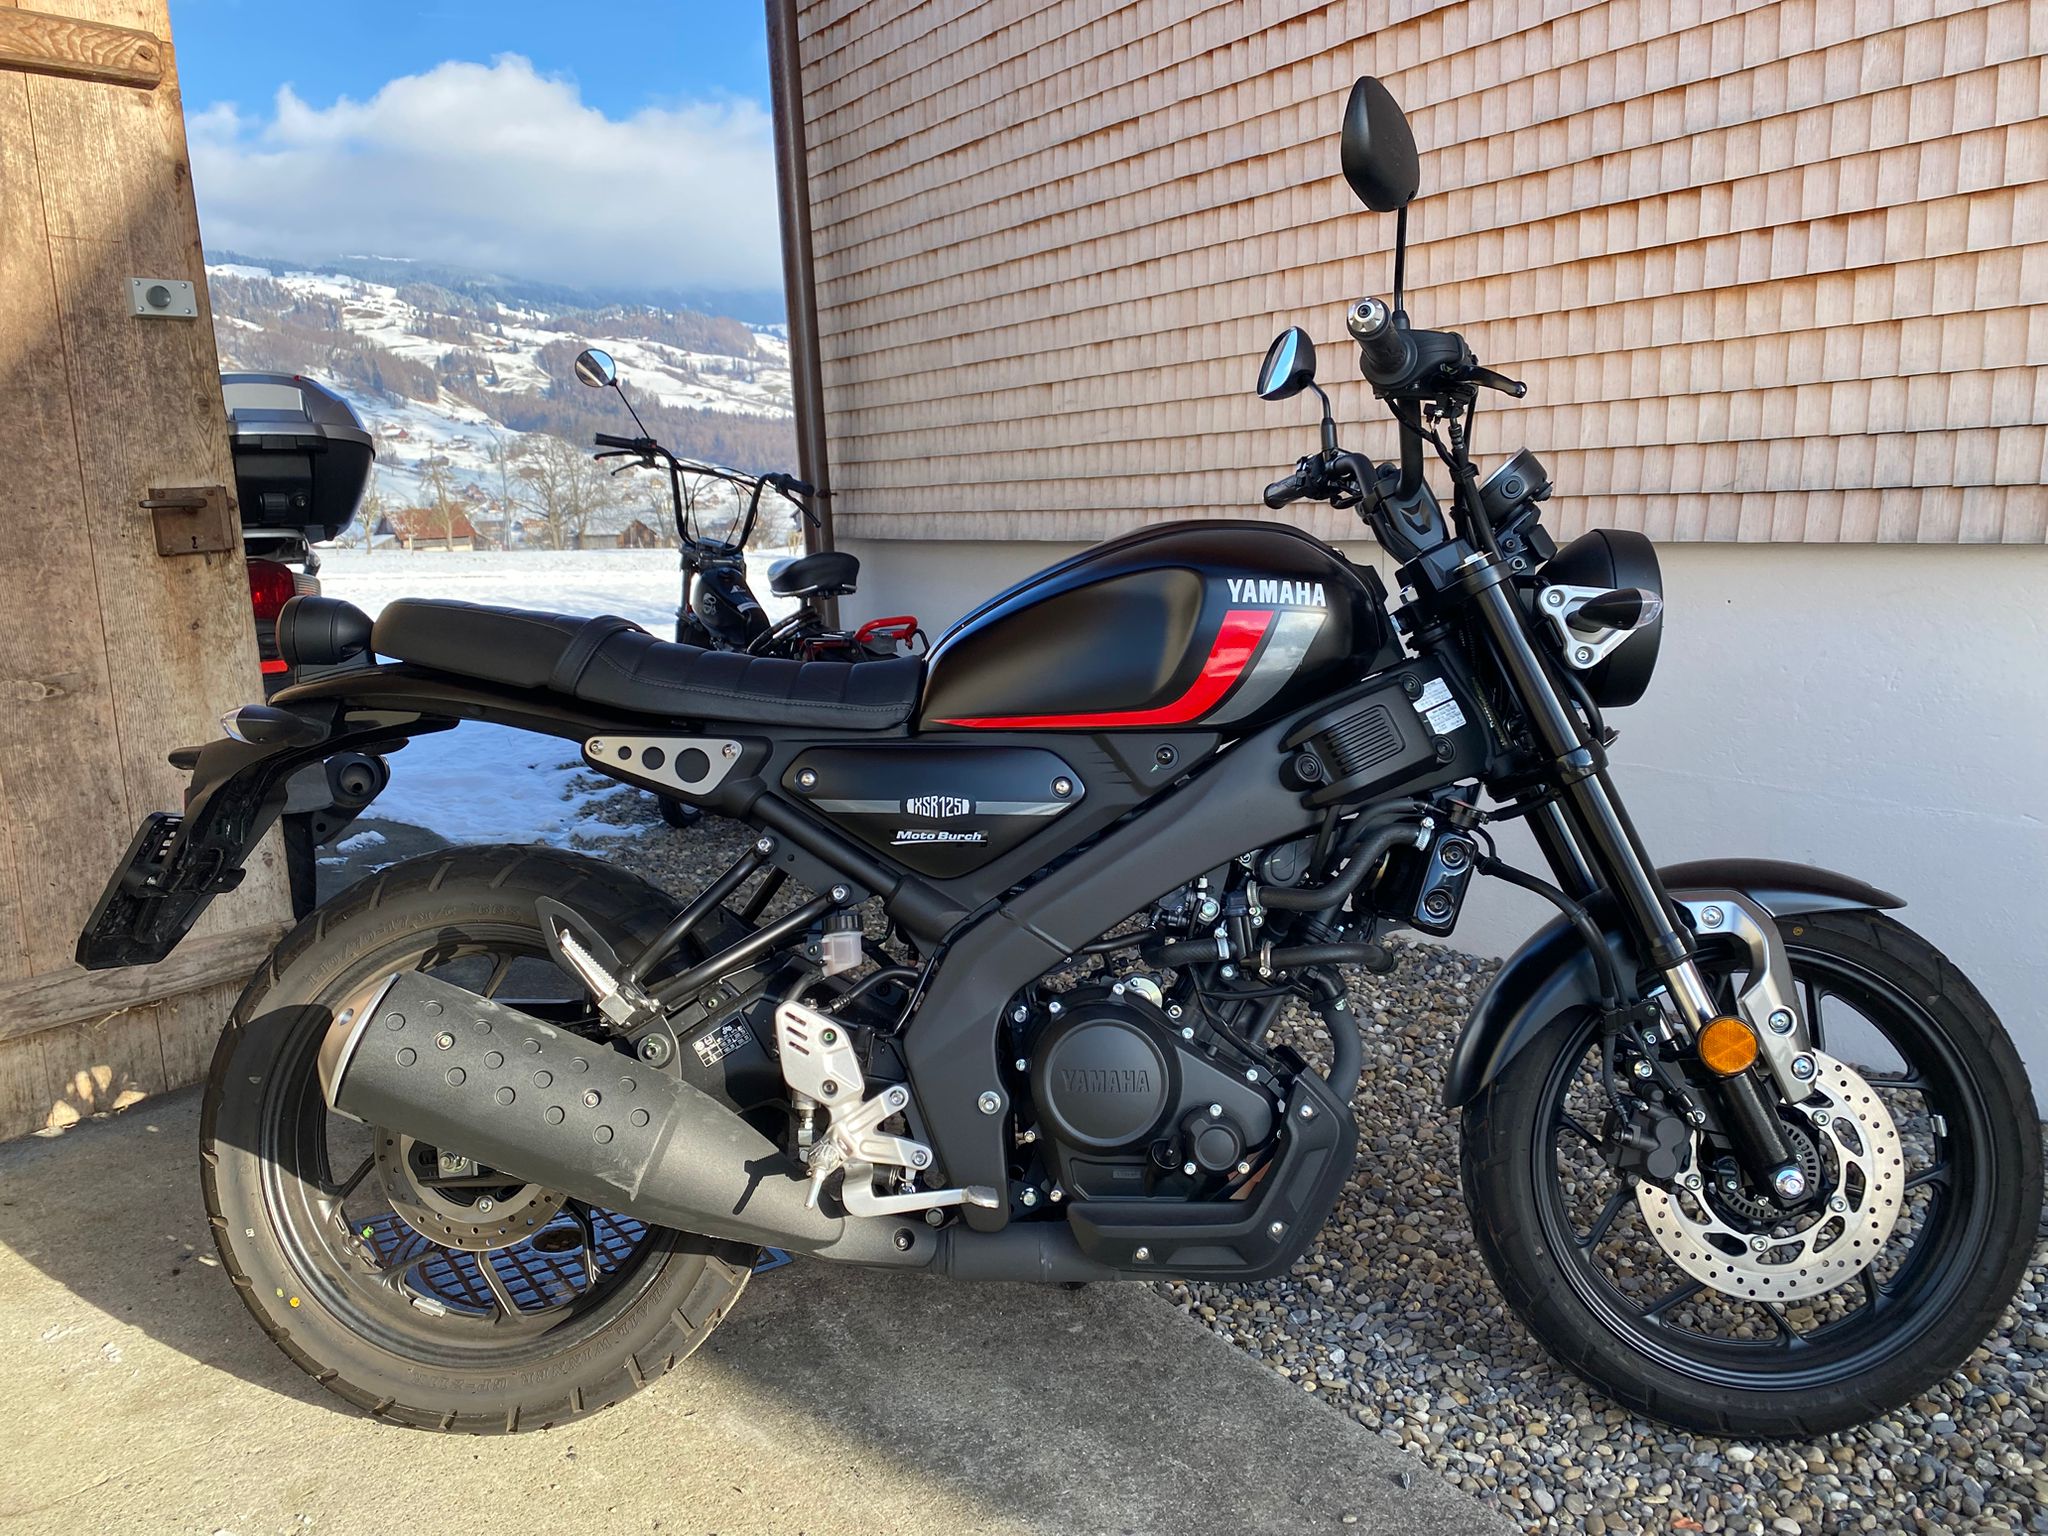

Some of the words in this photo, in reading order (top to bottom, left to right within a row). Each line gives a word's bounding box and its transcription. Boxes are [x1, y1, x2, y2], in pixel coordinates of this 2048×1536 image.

[1227, 579, 1327, 608] YAMAHA
[914, 795, 962, 818] XSR125
[896, 831, 936, 840] Moto
[938, 831, 982, 841] Burch
[1061, 1069, 1150, 1093] YAMAHA
